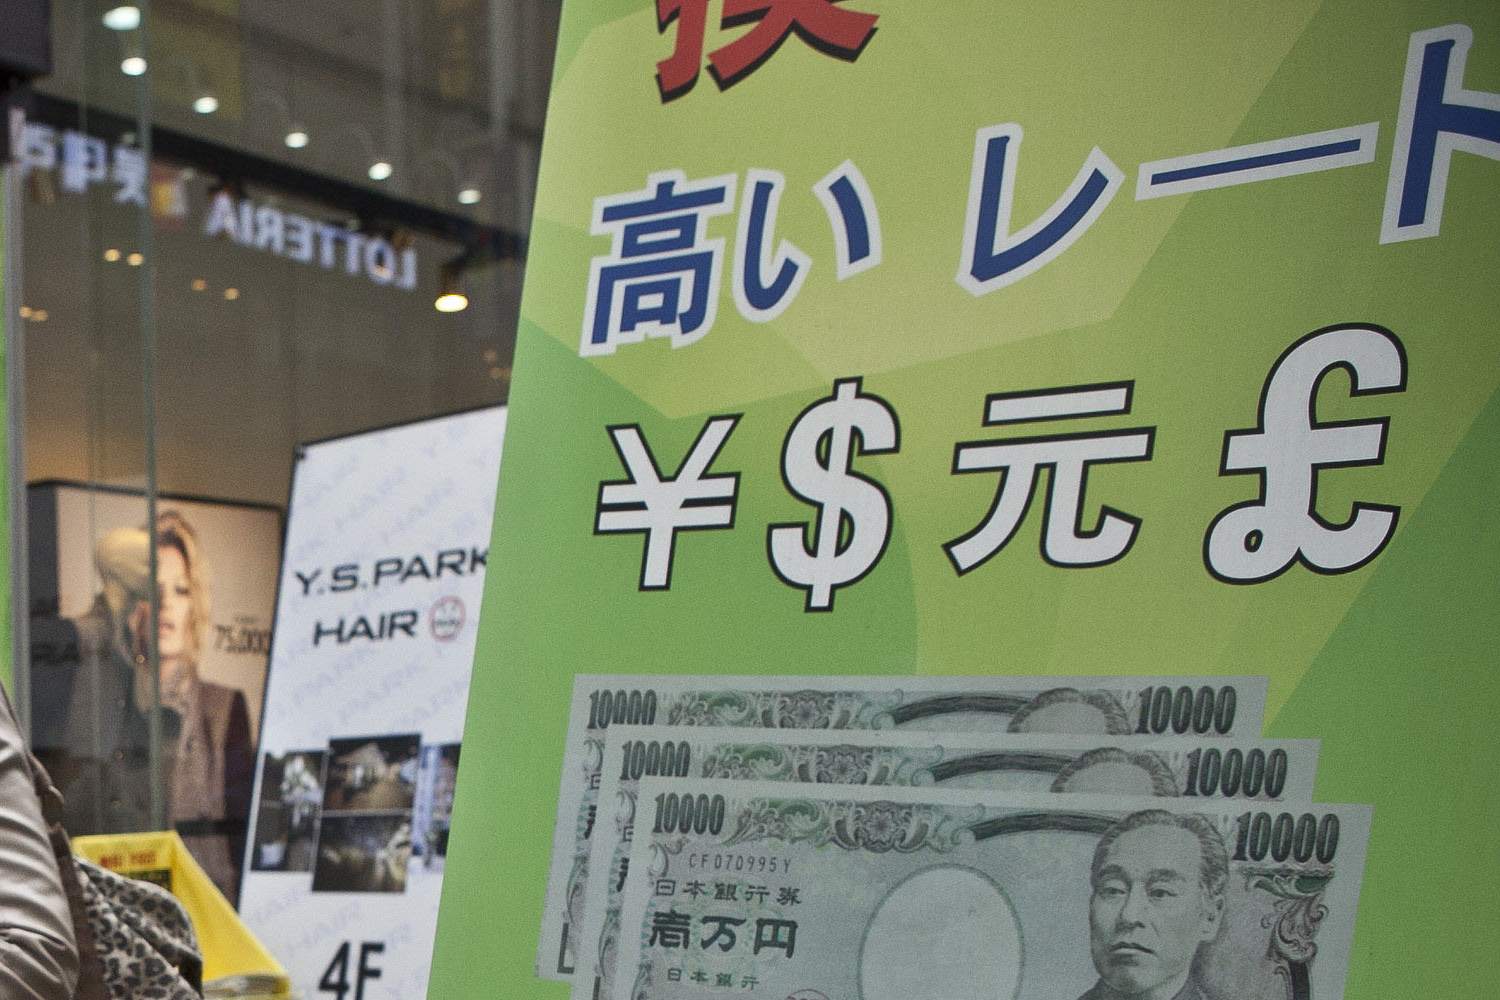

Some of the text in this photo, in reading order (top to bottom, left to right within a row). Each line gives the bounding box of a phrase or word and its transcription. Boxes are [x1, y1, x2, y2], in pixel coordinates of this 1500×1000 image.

[579, 159, 882, 357] 高い
[295, 547, 488, 596] Y.S.PARK
[313, 610, 418, 647] HAIR
[587, 686, 1236, 734] 10000 10000
[620, 741, 1287, 797] 10000 10000
[653, 792, 1339, 864] 10000 10000
[656, 879, 801, 906] 日本銀行券
[650, 910, 798, 958] 壱万円
[667, 968, 759, 990] 日本銀行
